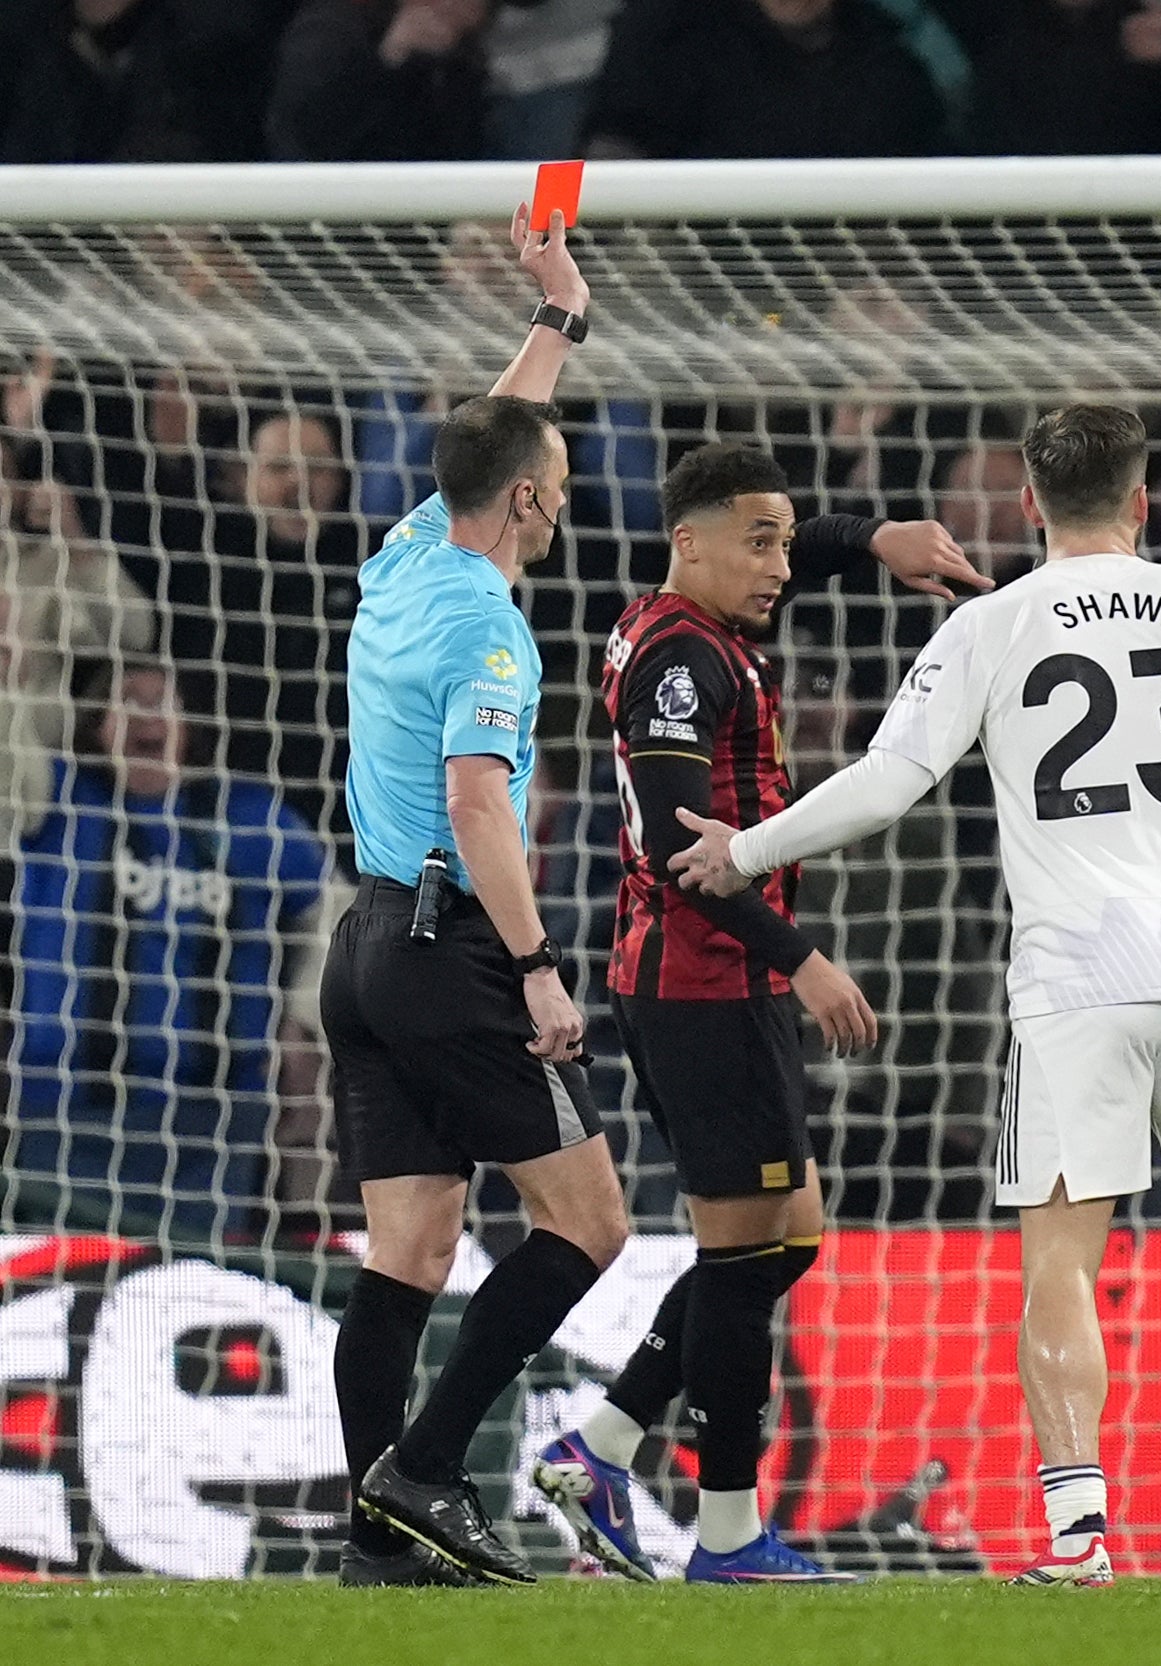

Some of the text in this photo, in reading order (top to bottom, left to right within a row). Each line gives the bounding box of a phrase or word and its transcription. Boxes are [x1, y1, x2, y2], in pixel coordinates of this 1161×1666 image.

[476, 707, 492, 717] No
[476, 717, 490, 725] for
[650, 718, 694, 733] No room
[649, 728, 698, 743] for racism
